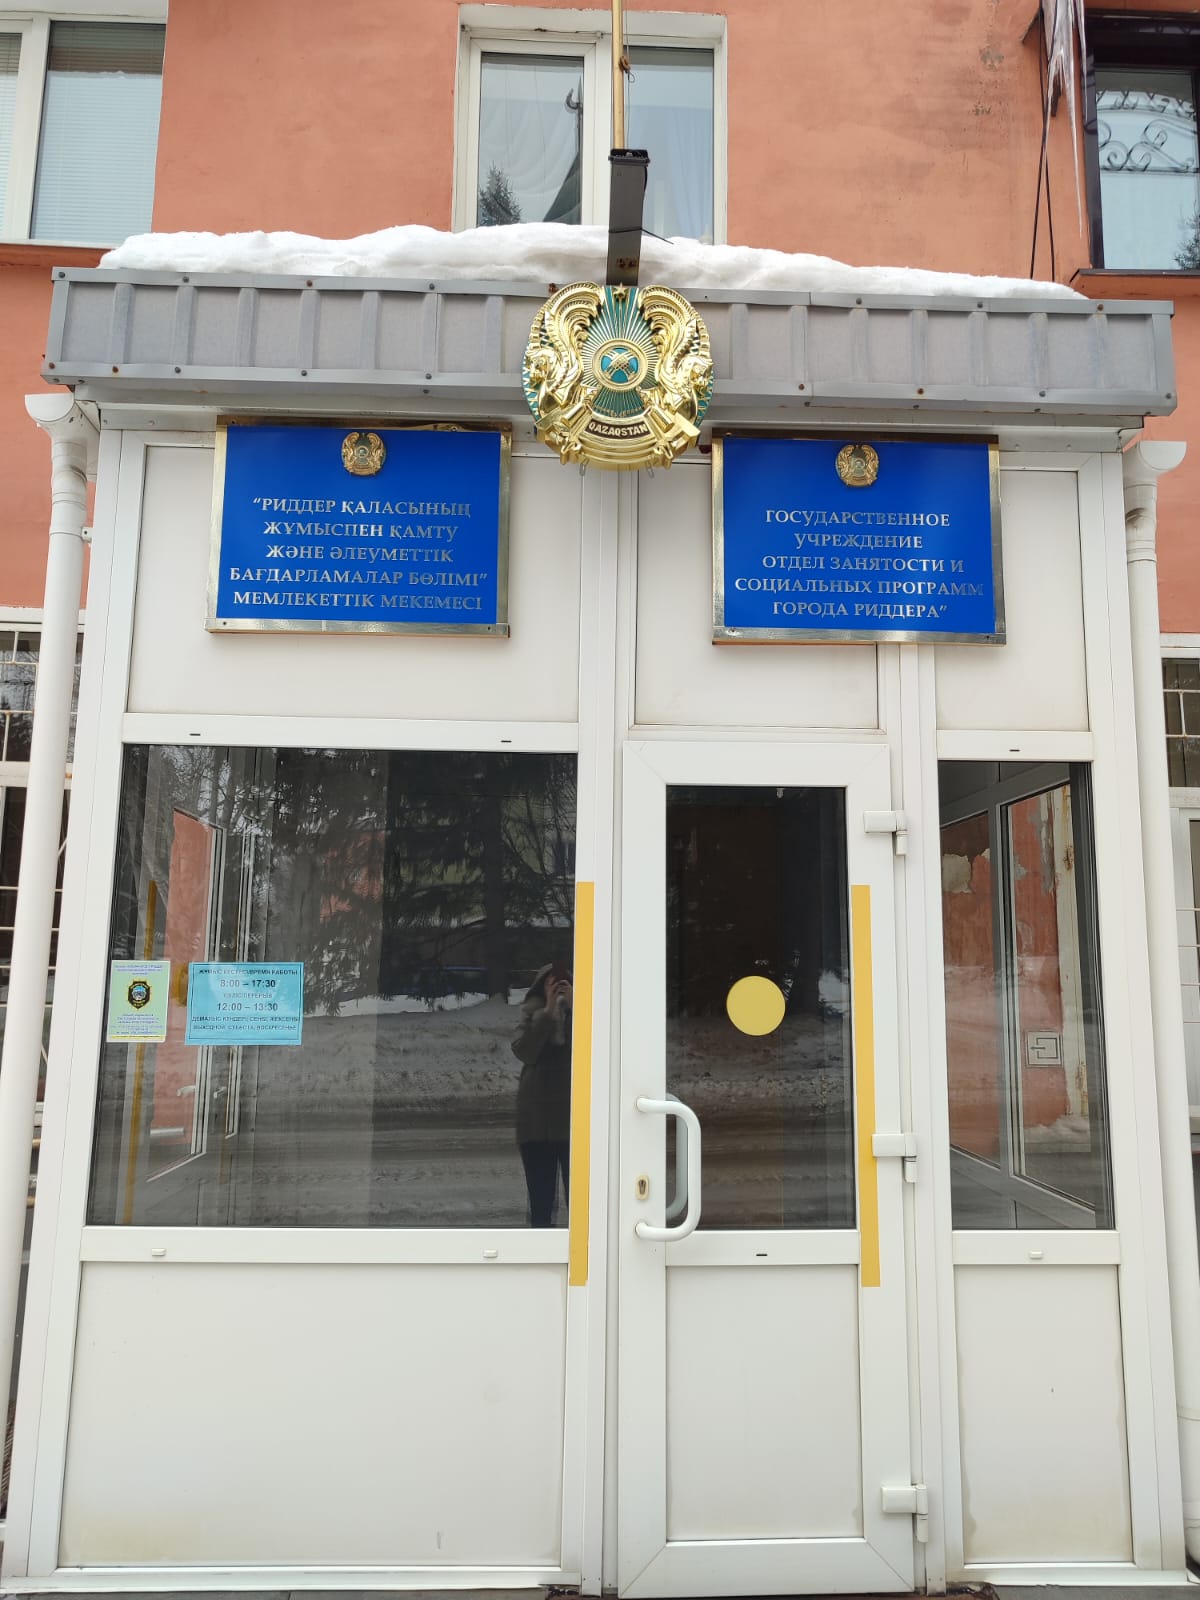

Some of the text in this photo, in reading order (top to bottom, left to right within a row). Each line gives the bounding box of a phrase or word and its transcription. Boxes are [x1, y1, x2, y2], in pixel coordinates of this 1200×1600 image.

[588, 422, 648, 437] QAZAQSTAN
[253, 498, 471, 518] “РИДДЕР ҚАЛАСЫНЫҢ
[765, 510, 950, 527] ГОСУДАРСТВЕННОЕ
[263, 521, 459, 542] ЖҰМЫСПЕН ҚАМТУ
[794, 533, 923, 550] УЧРЕЖДЕНИЕ
[265, 545, 455, 564] ЖӘНЕ ӘЛЕУМЕТТІК
[762, 555, 964, 573] ОТДЕЛ ЗАНЯТОСТИ И
[230, 567, 488, 587] БАҒДАРЛАМАЛАР БӨЛІМІ”
[735, 577, 985, 596] СОЦИАЛЬНЫХ ПРОГРАММ
[233, 591, 483, 610] МЕМЛЕКЕТТІК МЕКЕМЕСІ
[772, 601, 949, 620] ГОРОДА РИДДЕРА”
[219, 979, 240, 988] 8:00
[252, 979, 276, 988] 17:30
[217, 1002, 242, 1011] 12:00
[254, 1003, 278, 1011] 13:30
